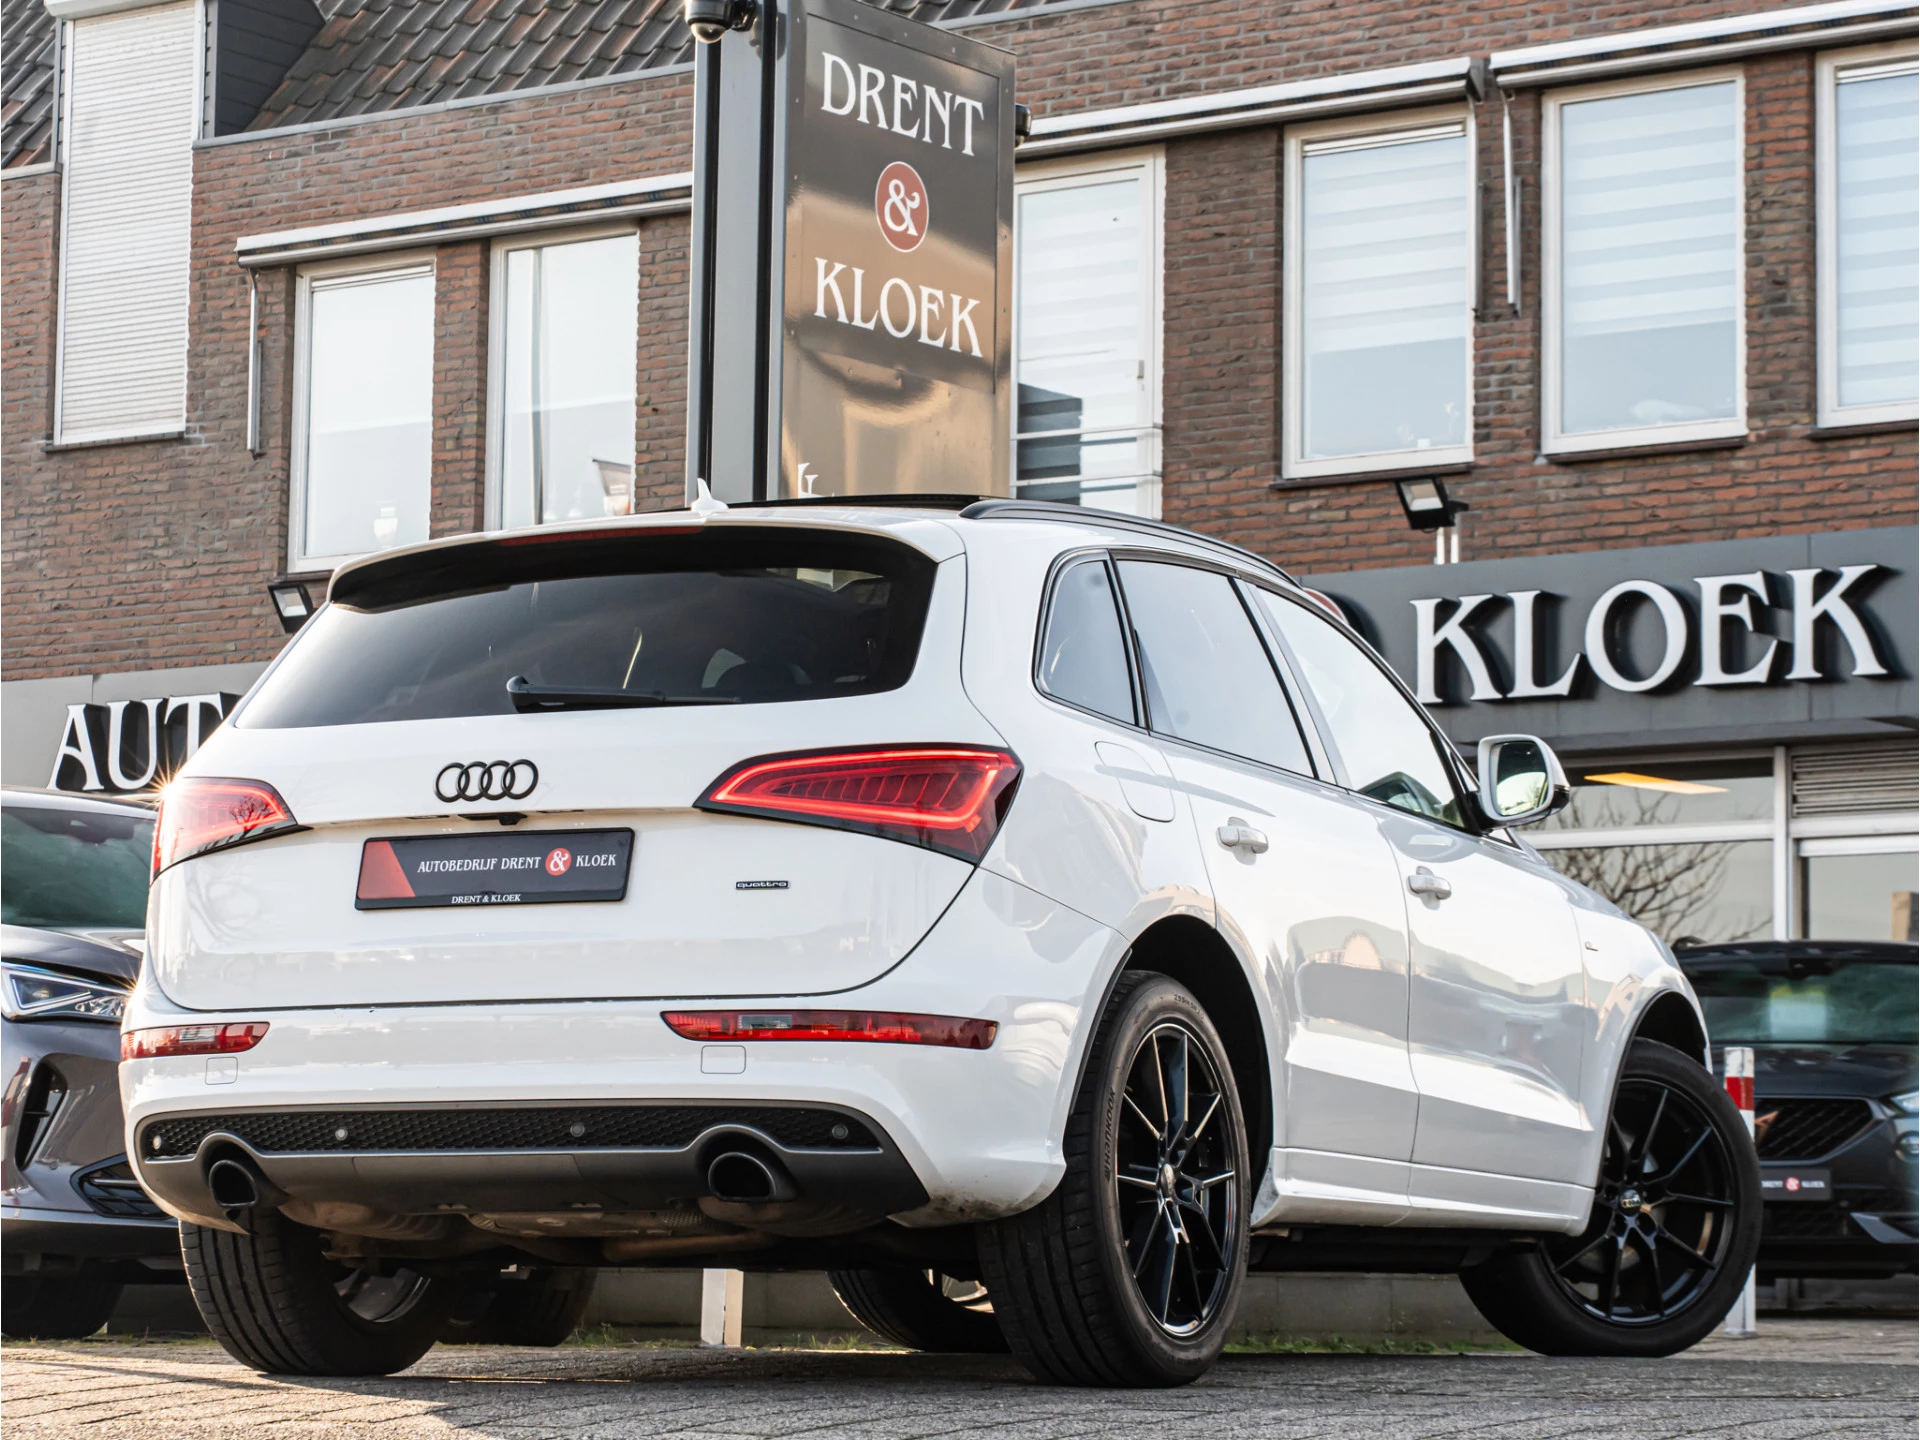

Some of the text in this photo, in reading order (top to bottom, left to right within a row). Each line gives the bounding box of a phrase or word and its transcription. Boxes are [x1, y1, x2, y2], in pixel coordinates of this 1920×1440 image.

[820, 51, 984, 157] DRENT
[883, 178, 921, 237] &
[813, 256, 983, 359] KLOEK
[1409, 563, 1890, 705] KLOEK
[417, 850, 617, 874] AUTOBEDRIJF DRENT & KLOEK
[451, 893, 521, 904] DRENT & KLOEK
